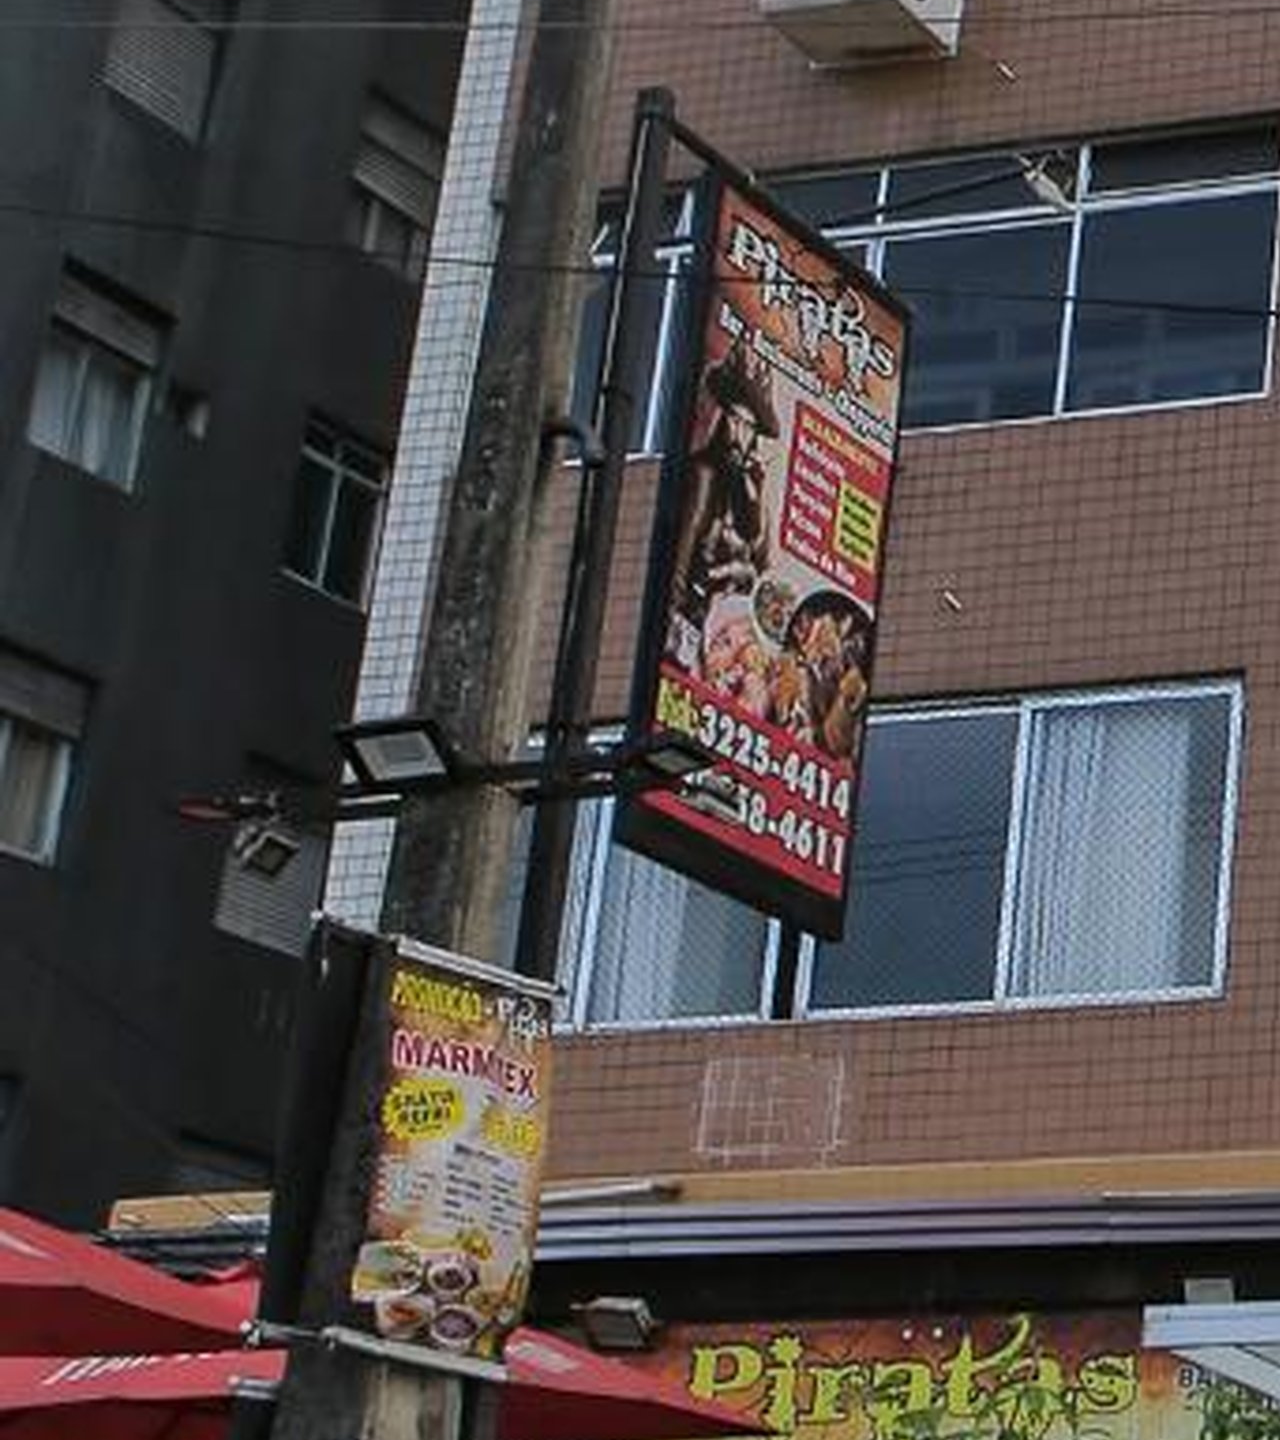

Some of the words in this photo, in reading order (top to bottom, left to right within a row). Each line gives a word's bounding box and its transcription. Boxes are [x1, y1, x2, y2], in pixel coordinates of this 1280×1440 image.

[728, 222, 895, 388] Piratas
[699, 703, 851, 819] 3225-4414
[392, 1028, 539, 1099] MARMEX
